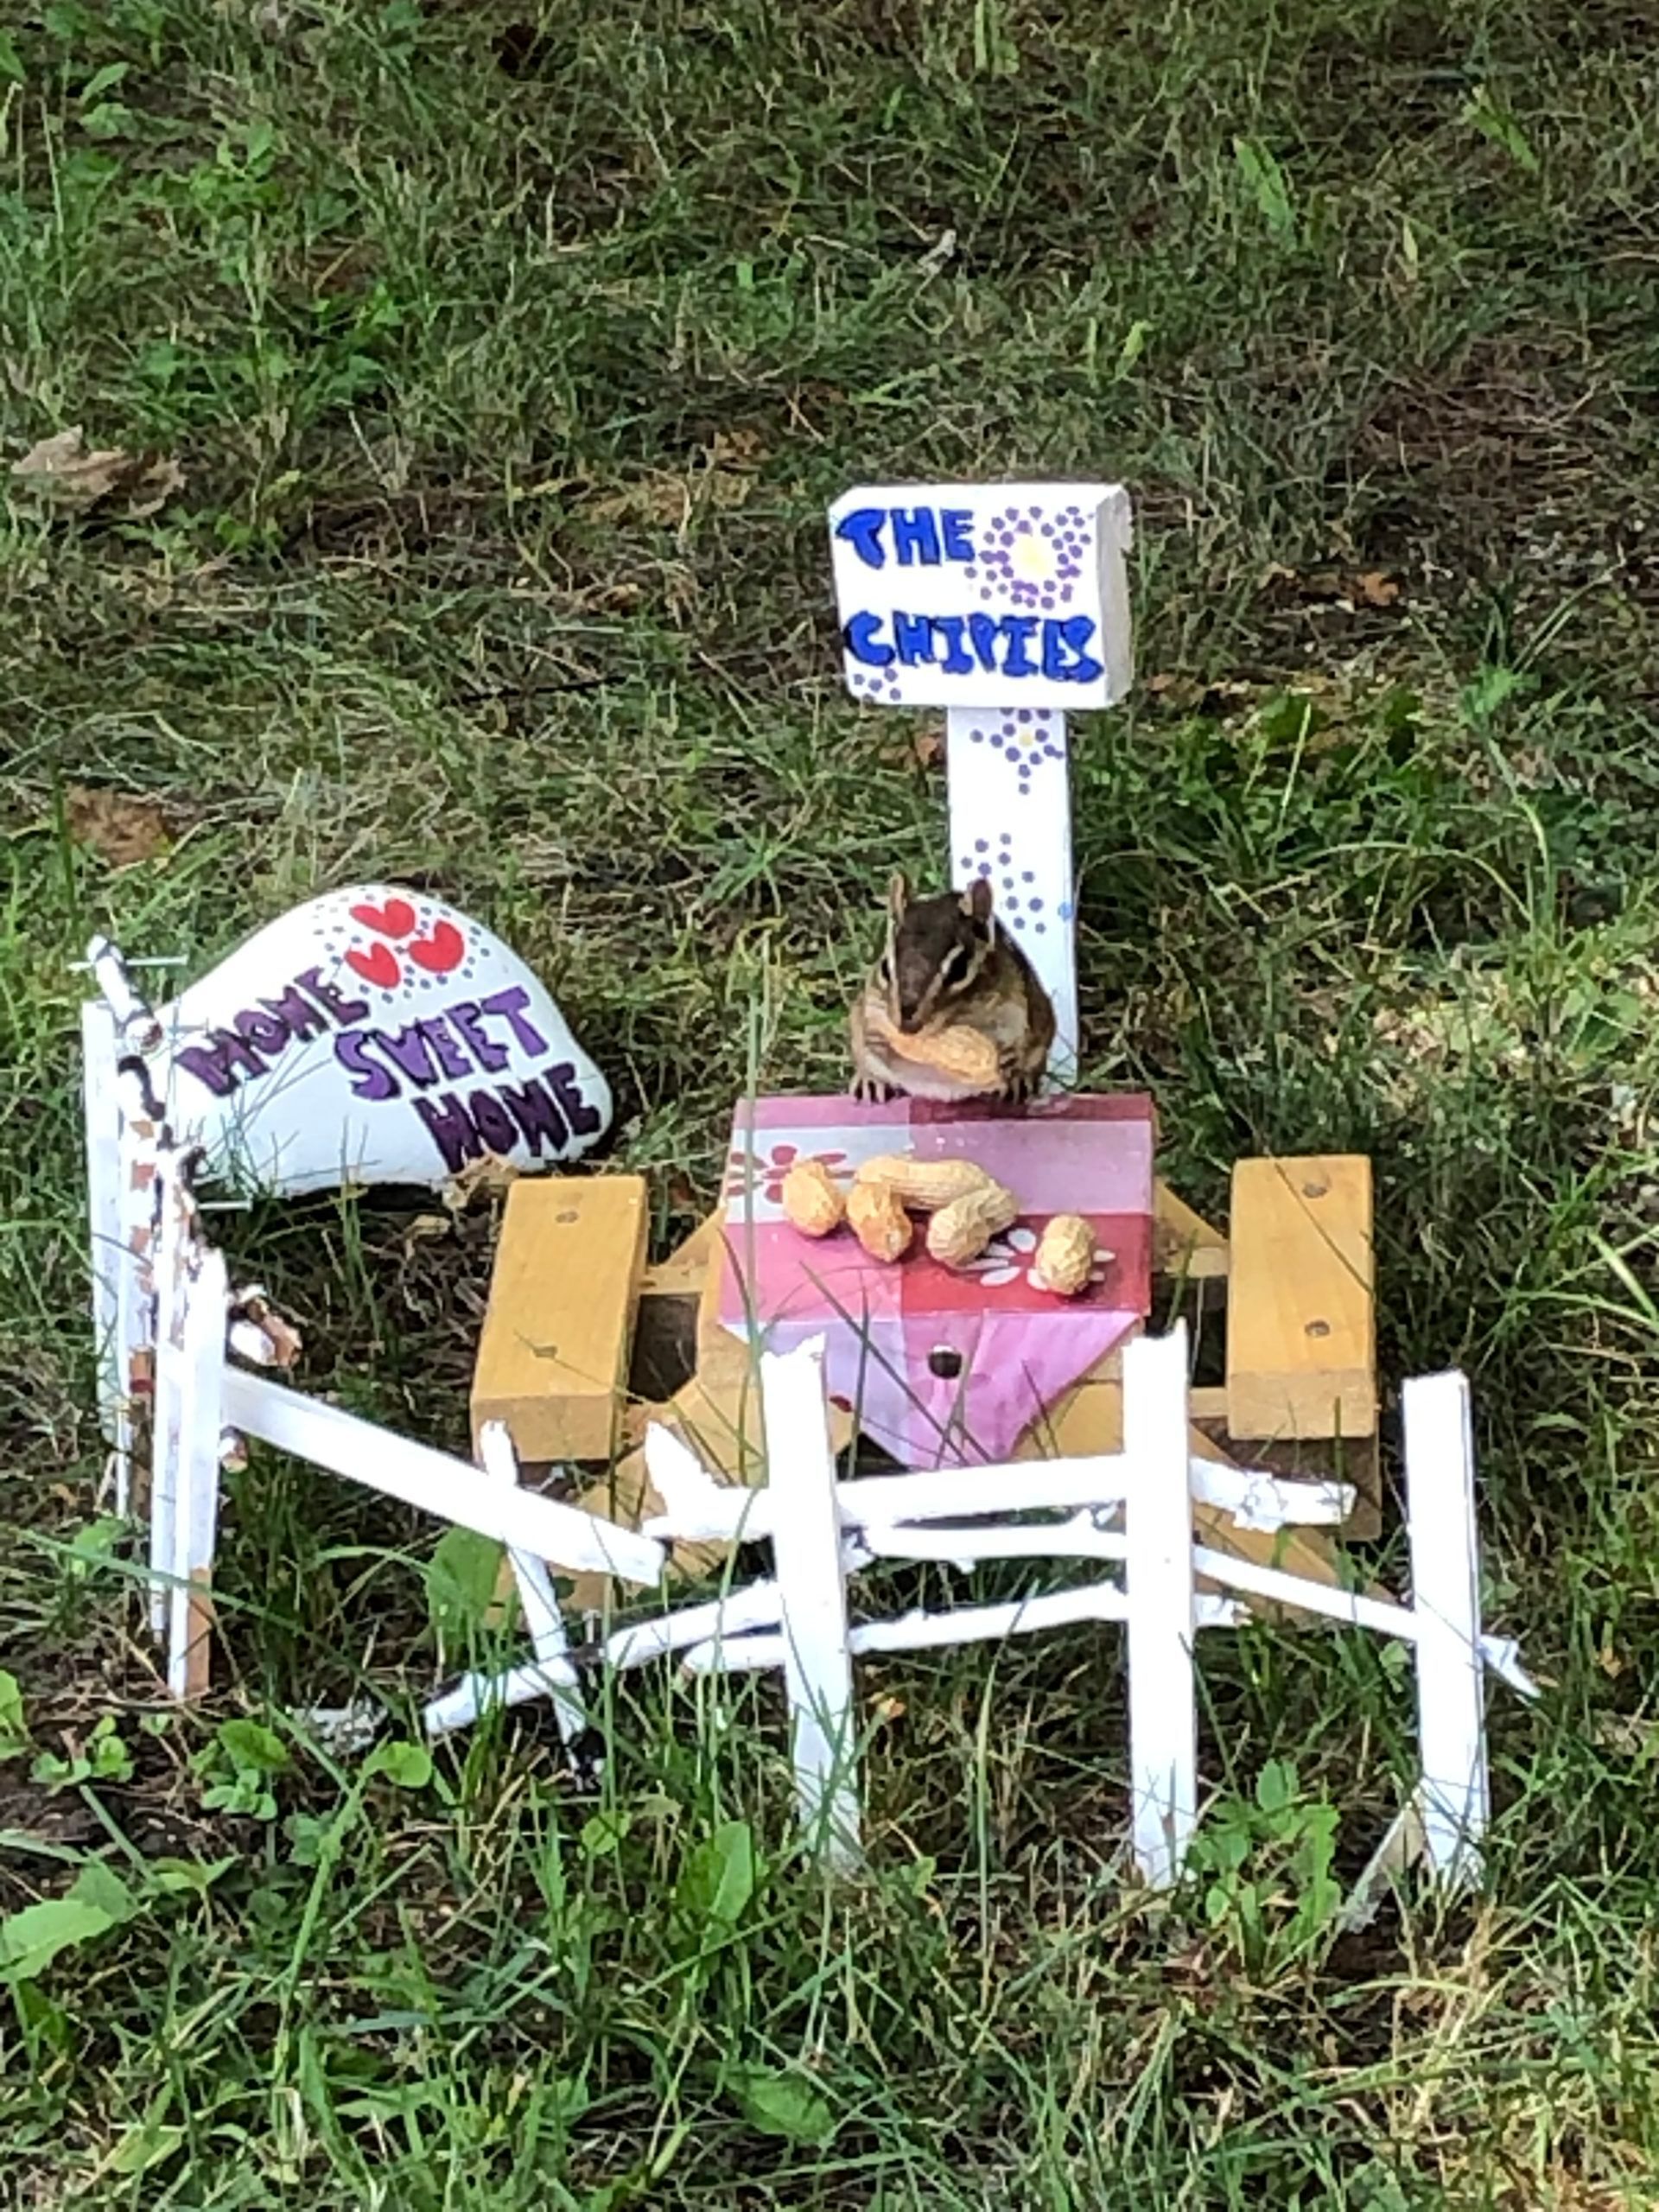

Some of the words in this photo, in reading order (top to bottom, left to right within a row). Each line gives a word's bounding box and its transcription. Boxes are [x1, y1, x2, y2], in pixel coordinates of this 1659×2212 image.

[836, 506, 976, 570] THE
[843, 610, 1104, 683] CHIPIES
[174, 967, 370, 1097] HOME
[334, 986, 548, 1101] SWEET
[412, 1062, 600, 1174] HOME
